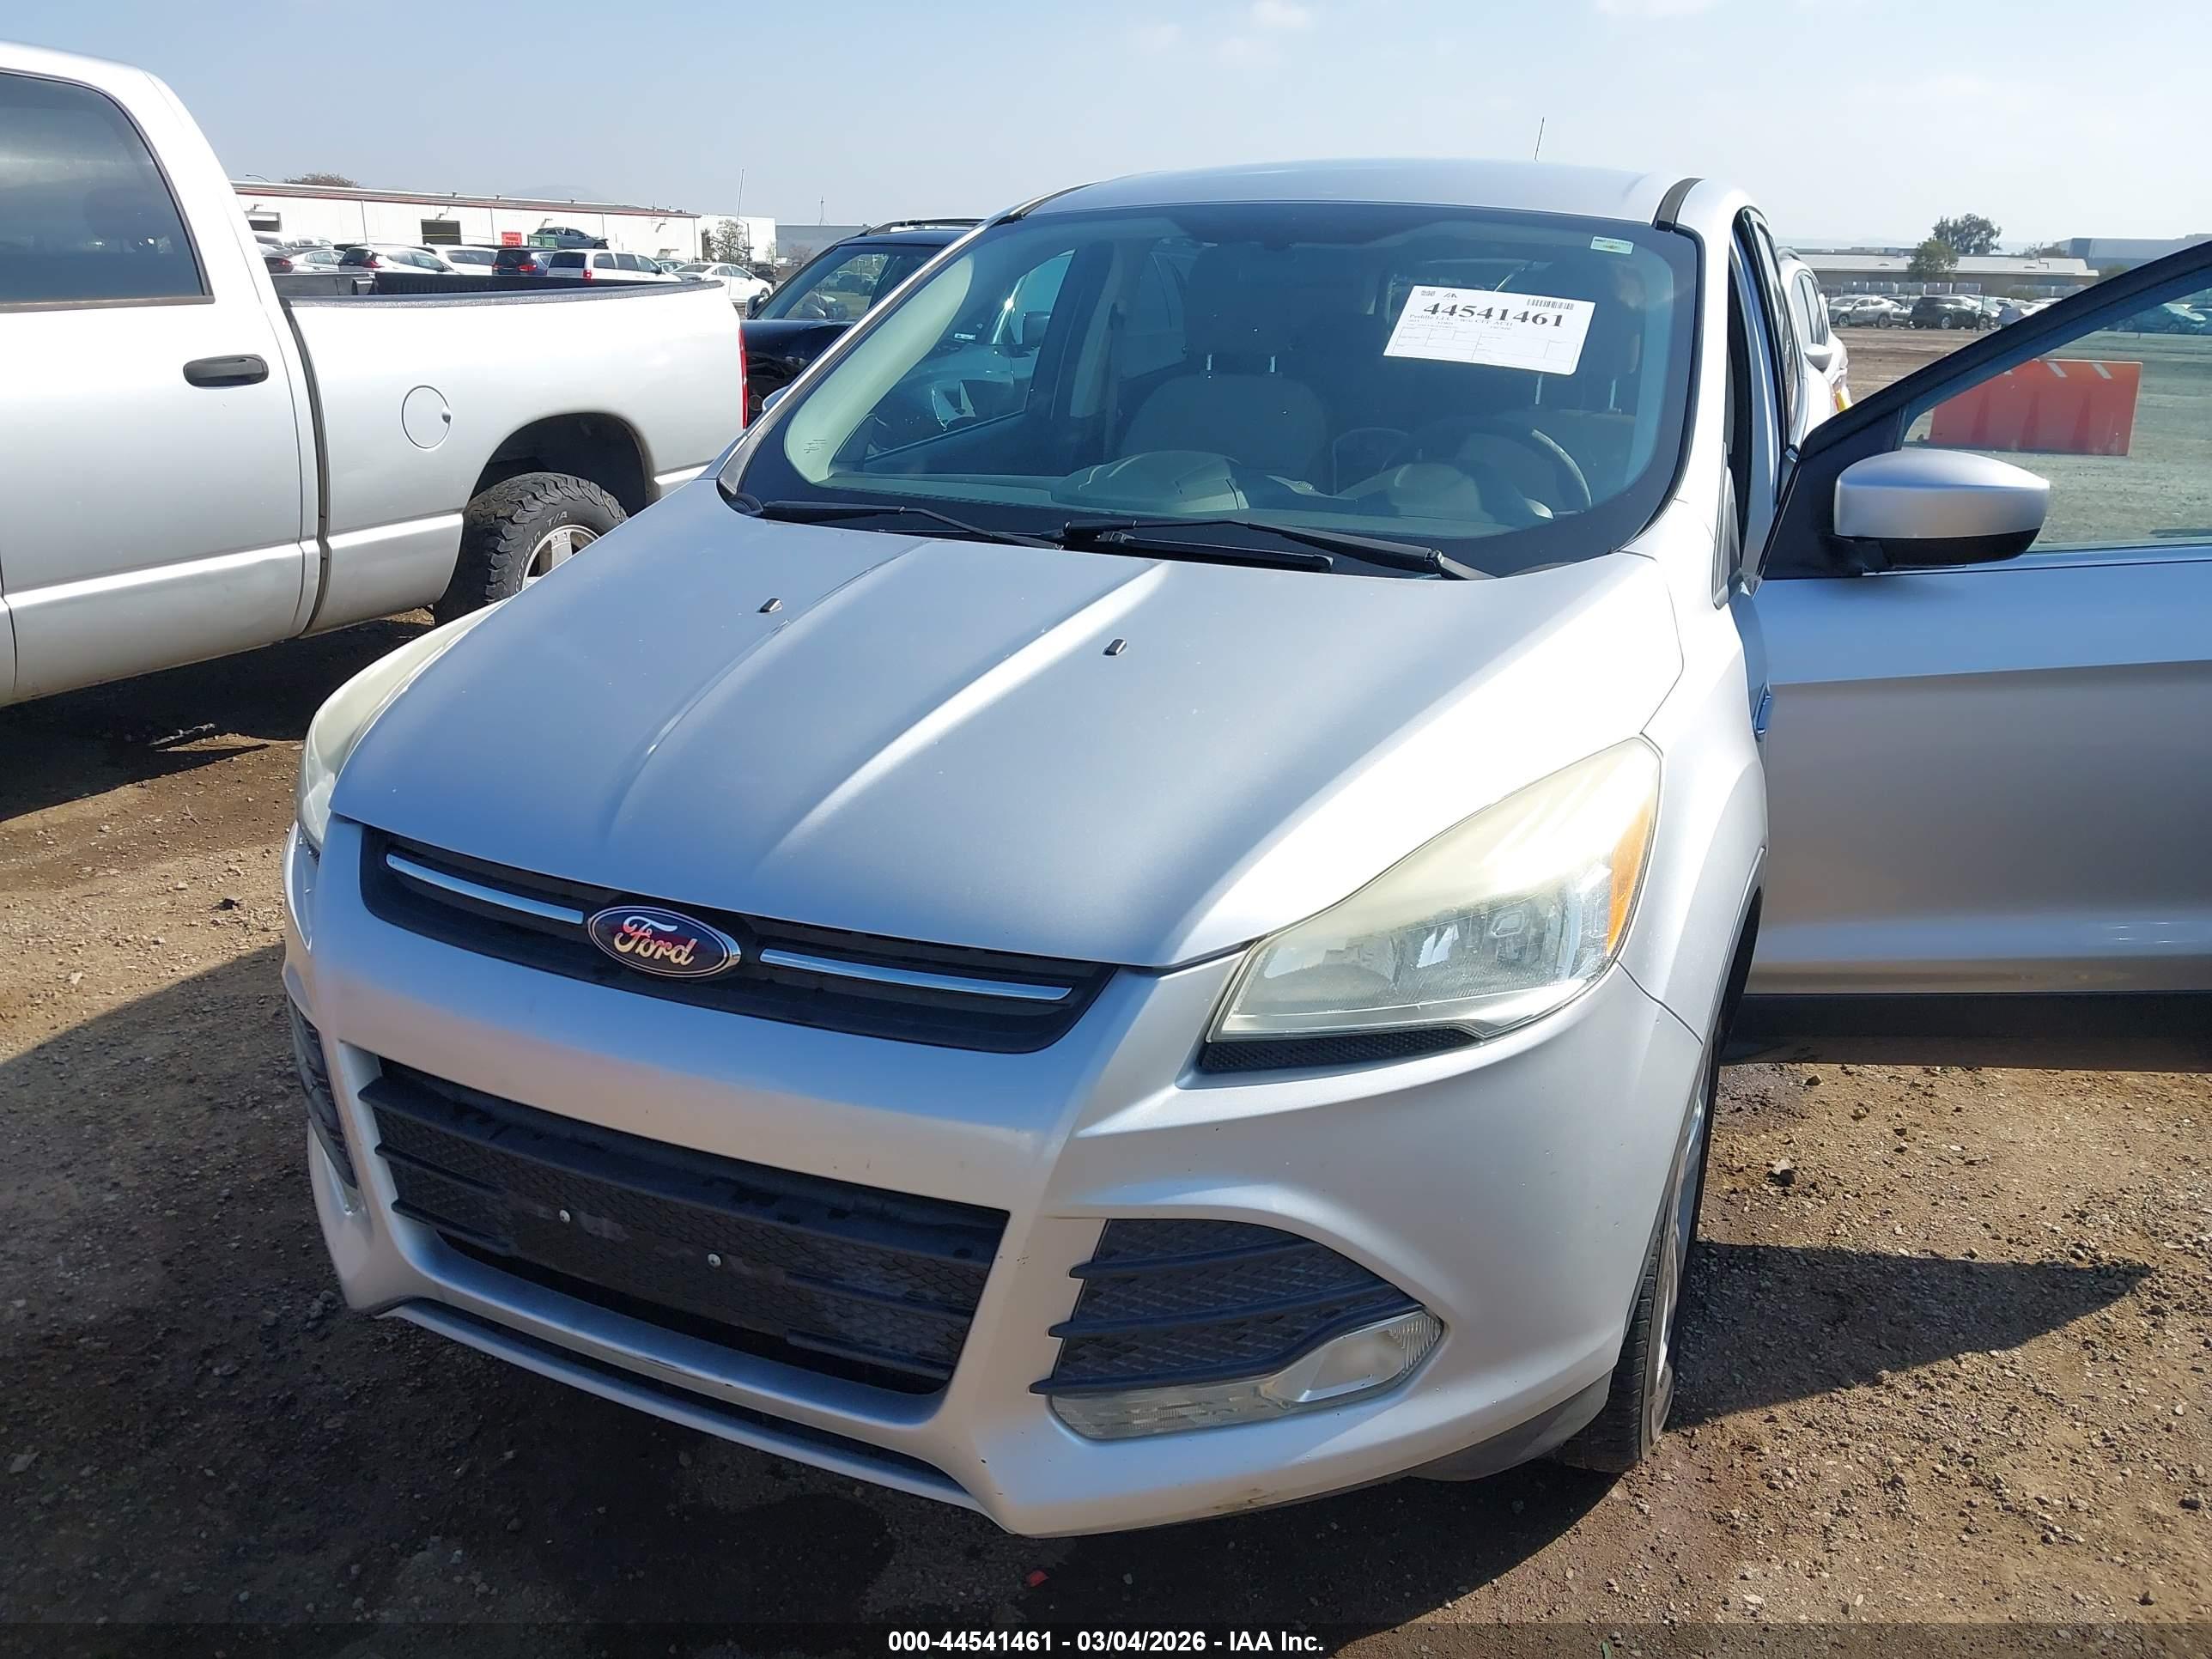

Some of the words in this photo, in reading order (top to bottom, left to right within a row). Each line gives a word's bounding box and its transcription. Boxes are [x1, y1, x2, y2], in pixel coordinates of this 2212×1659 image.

[1424, 302, 1564, 327] 44541461
[546, 511, 568, 527] T/A
[613, 915, 699, 966] Ford
